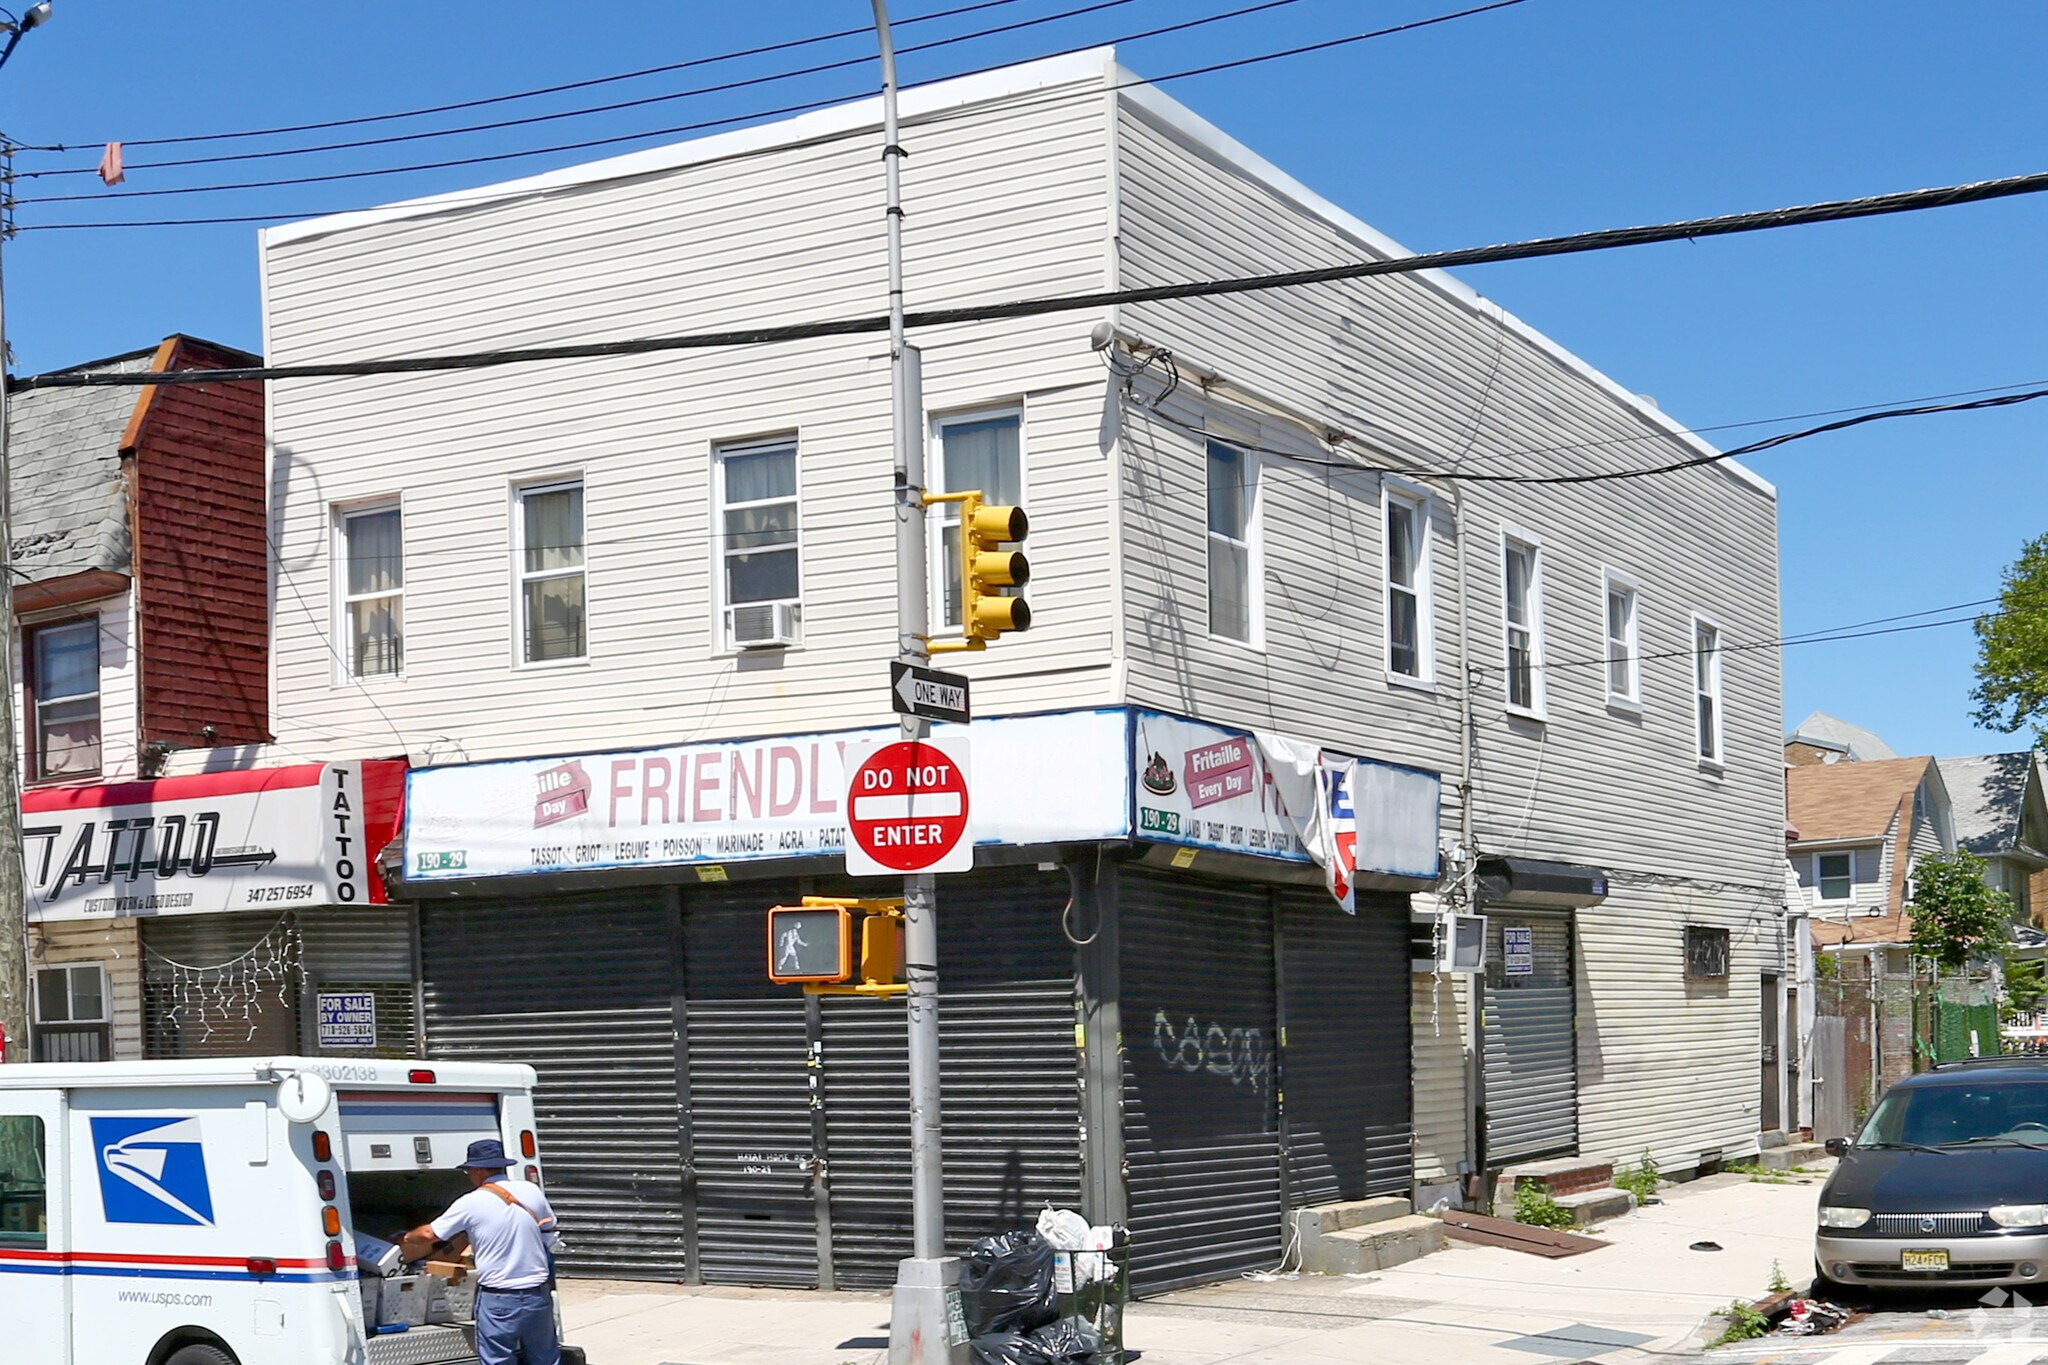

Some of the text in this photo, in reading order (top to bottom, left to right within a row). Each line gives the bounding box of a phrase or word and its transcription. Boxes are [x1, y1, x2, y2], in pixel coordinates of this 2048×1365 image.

[915, 682, 964, 708] ONE WAY
[1192, 744, 1242, 773] Fritaille
[609, 741, 868, 828] FRIENDL
[864, 766, 949, 790] DO NOT
[1197, 775, 1242, 799] Every Day
[542, 800, 566, 817] Day
[332, 768, 355, 902] TATTOO
[873, 825, 942, 846] ENTER
[23, 813, 220, 905] TATTOO
[531, 846, 563, 866] TASSOT
[575, 843, 601, 863] GRIOT
[615, 840, 650, 860] LEGUME
[663, 836, 702, 857] POISSON
[716, 832, 764, 854] MARINADE
[779, 830, 804, 849] ACRA
[247, 884, 313, 903] 347 257 6954
[320, 998, 371, 1011] FOR SALE
[321, 1012, 371, 1023] BY OWNER
[118, 1290, 212, 1308] www.usps.com
